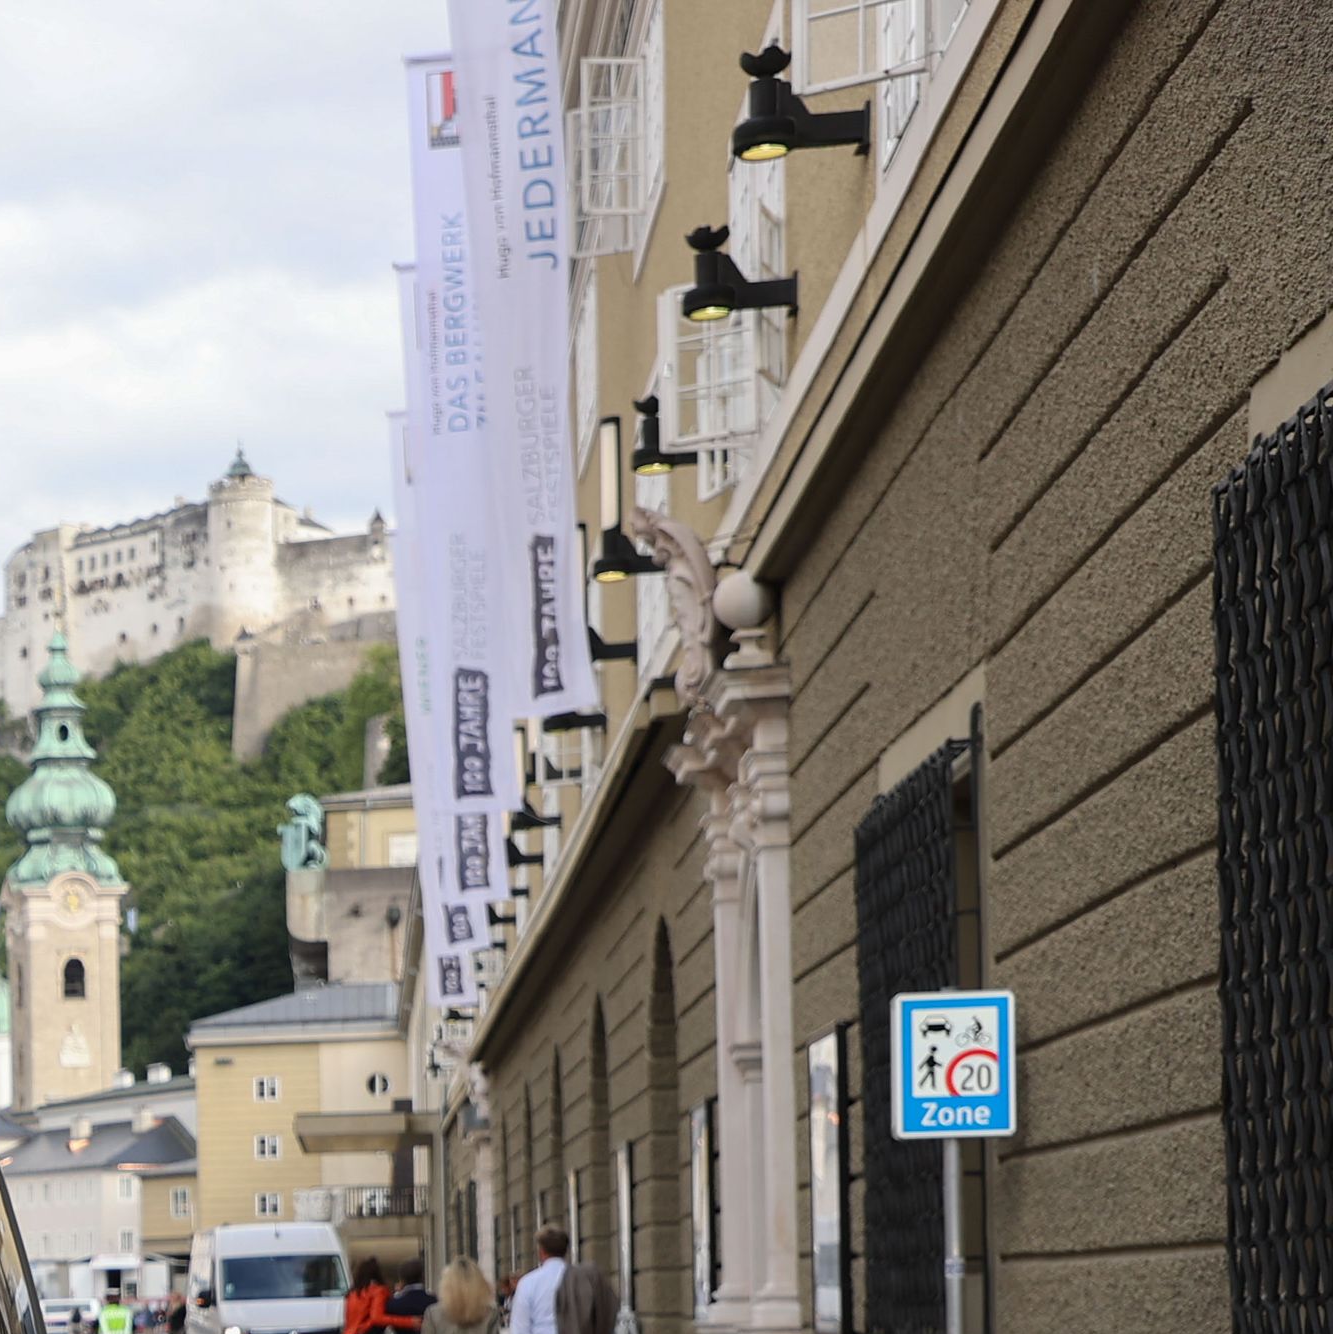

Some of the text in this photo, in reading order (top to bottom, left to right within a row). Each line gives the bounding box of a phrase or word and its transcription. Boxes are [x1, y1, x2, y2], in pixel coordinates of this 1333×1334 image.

[440, 210, 469, 433] DAS BERGWERK
[456, 675, 484, 753] JAHRE
[960, 1064, 992, 1091] 20
[920, 1102, 992, 1127] Zone
